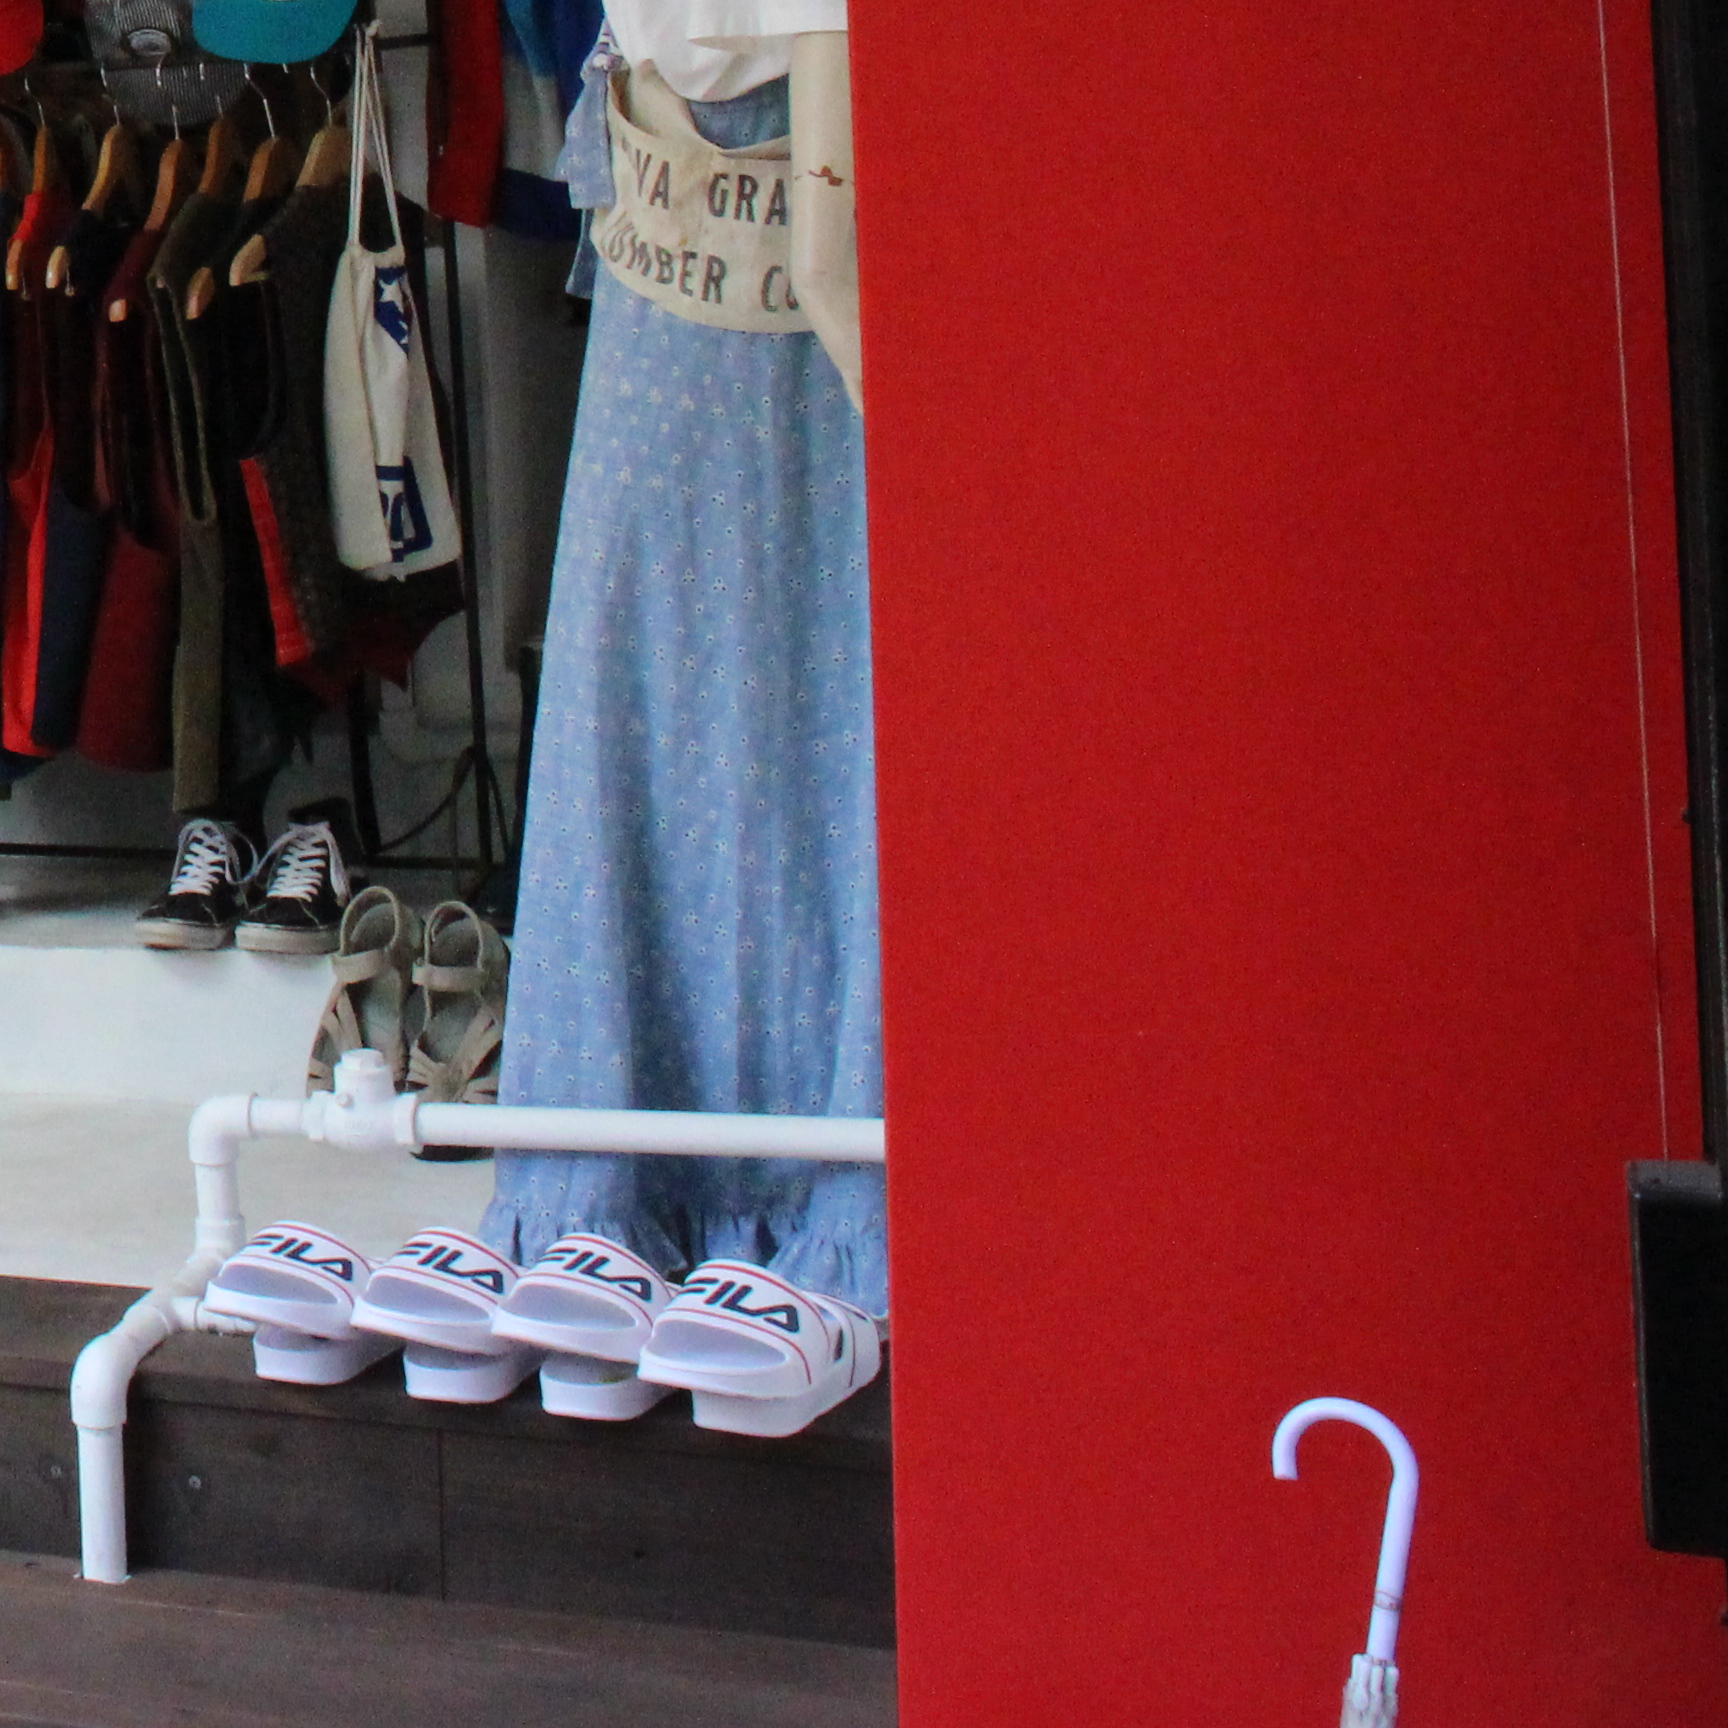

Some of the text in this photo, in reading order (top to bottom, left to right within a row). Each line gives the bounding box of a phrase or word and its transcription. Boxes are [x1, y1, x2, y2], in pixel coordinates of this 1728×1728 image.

[621, 137, 788, 226] VA GRA
[244, 1233, 353, 1282] FILA
[394, 1241, 505, 1295] FILA
[539, 1247, 652, 1302] FILA
[676, 1276, 800, 1334] FILA
